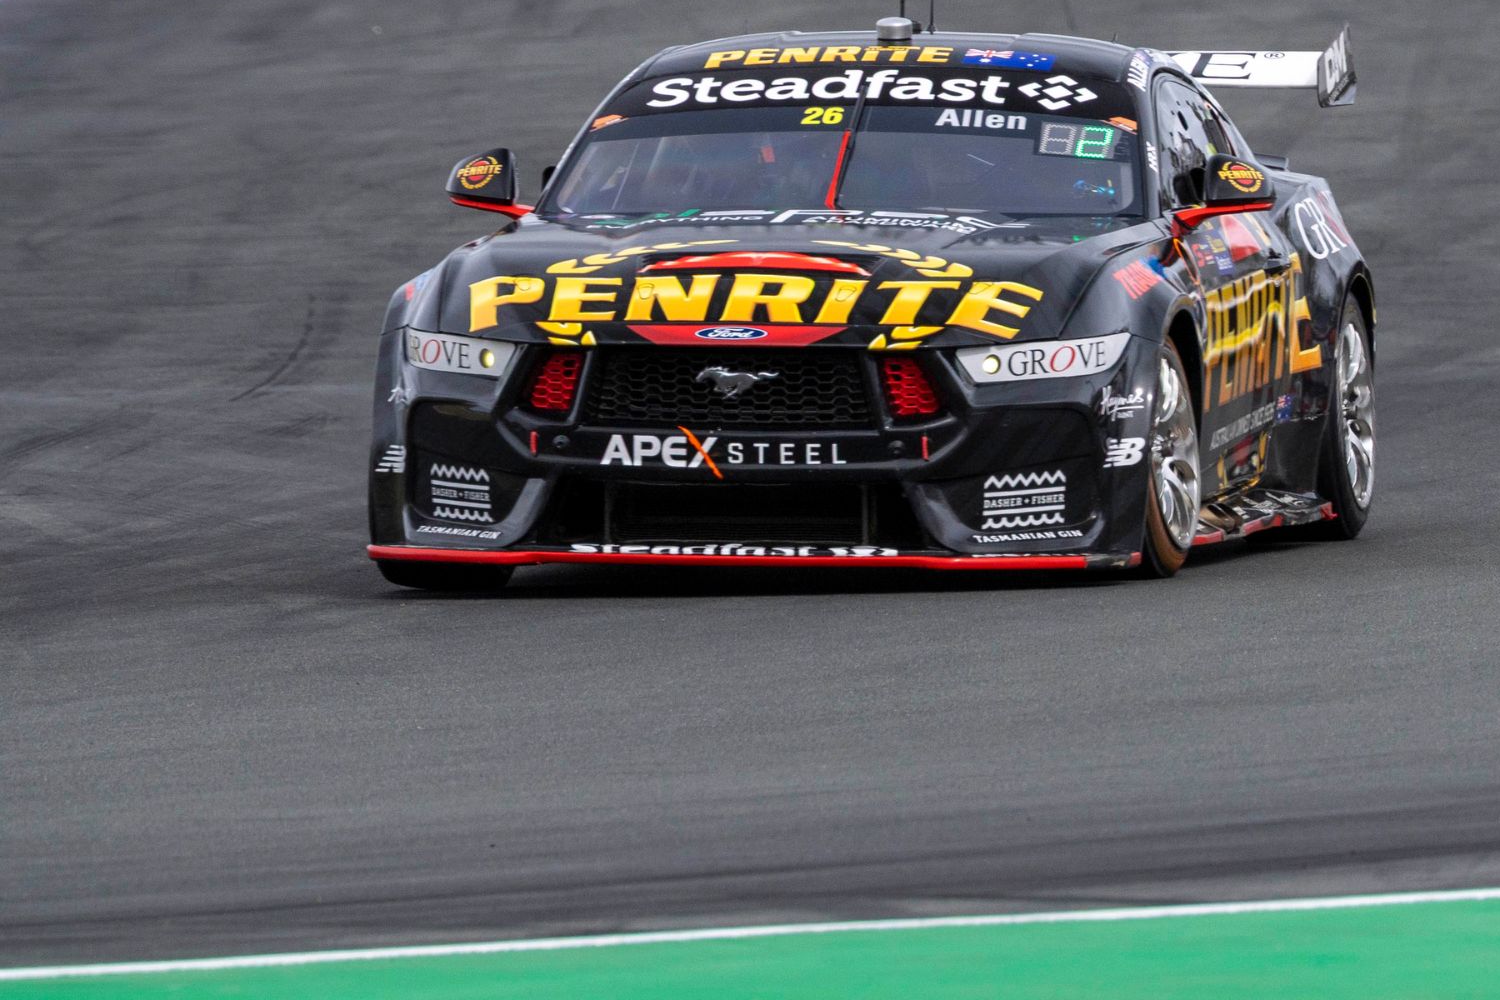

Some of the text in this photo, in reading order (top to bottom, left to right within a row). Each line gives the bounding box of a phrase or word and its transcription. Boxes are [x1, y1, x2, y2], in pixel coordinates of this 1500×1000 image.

[704, 45, 954, 69] PENRITE
[646, 69, 1007, 108] Steadfast
[800, 106, 1027, 130] 26 Allen
[456, 162, 503, 178] PENRITE
[1218, 170, 1264, 180] PENRITE
[469, 271, 1044, 340] PENRITE
[711, 326, 755, 340] Ford
[405, 338, 471, 370] ROVE
[1008, 340, 1106, 377] GROVE
[600, 425, 847, 479] APEX STEEL
[983, 495, 1024, 509] DASHER
[1031, 493, 1065, 506] FISHER
[416, 525, 502, 540] TASMANIAN GIN
[973, 529, 1084, 544] TASMANIAN GIN
